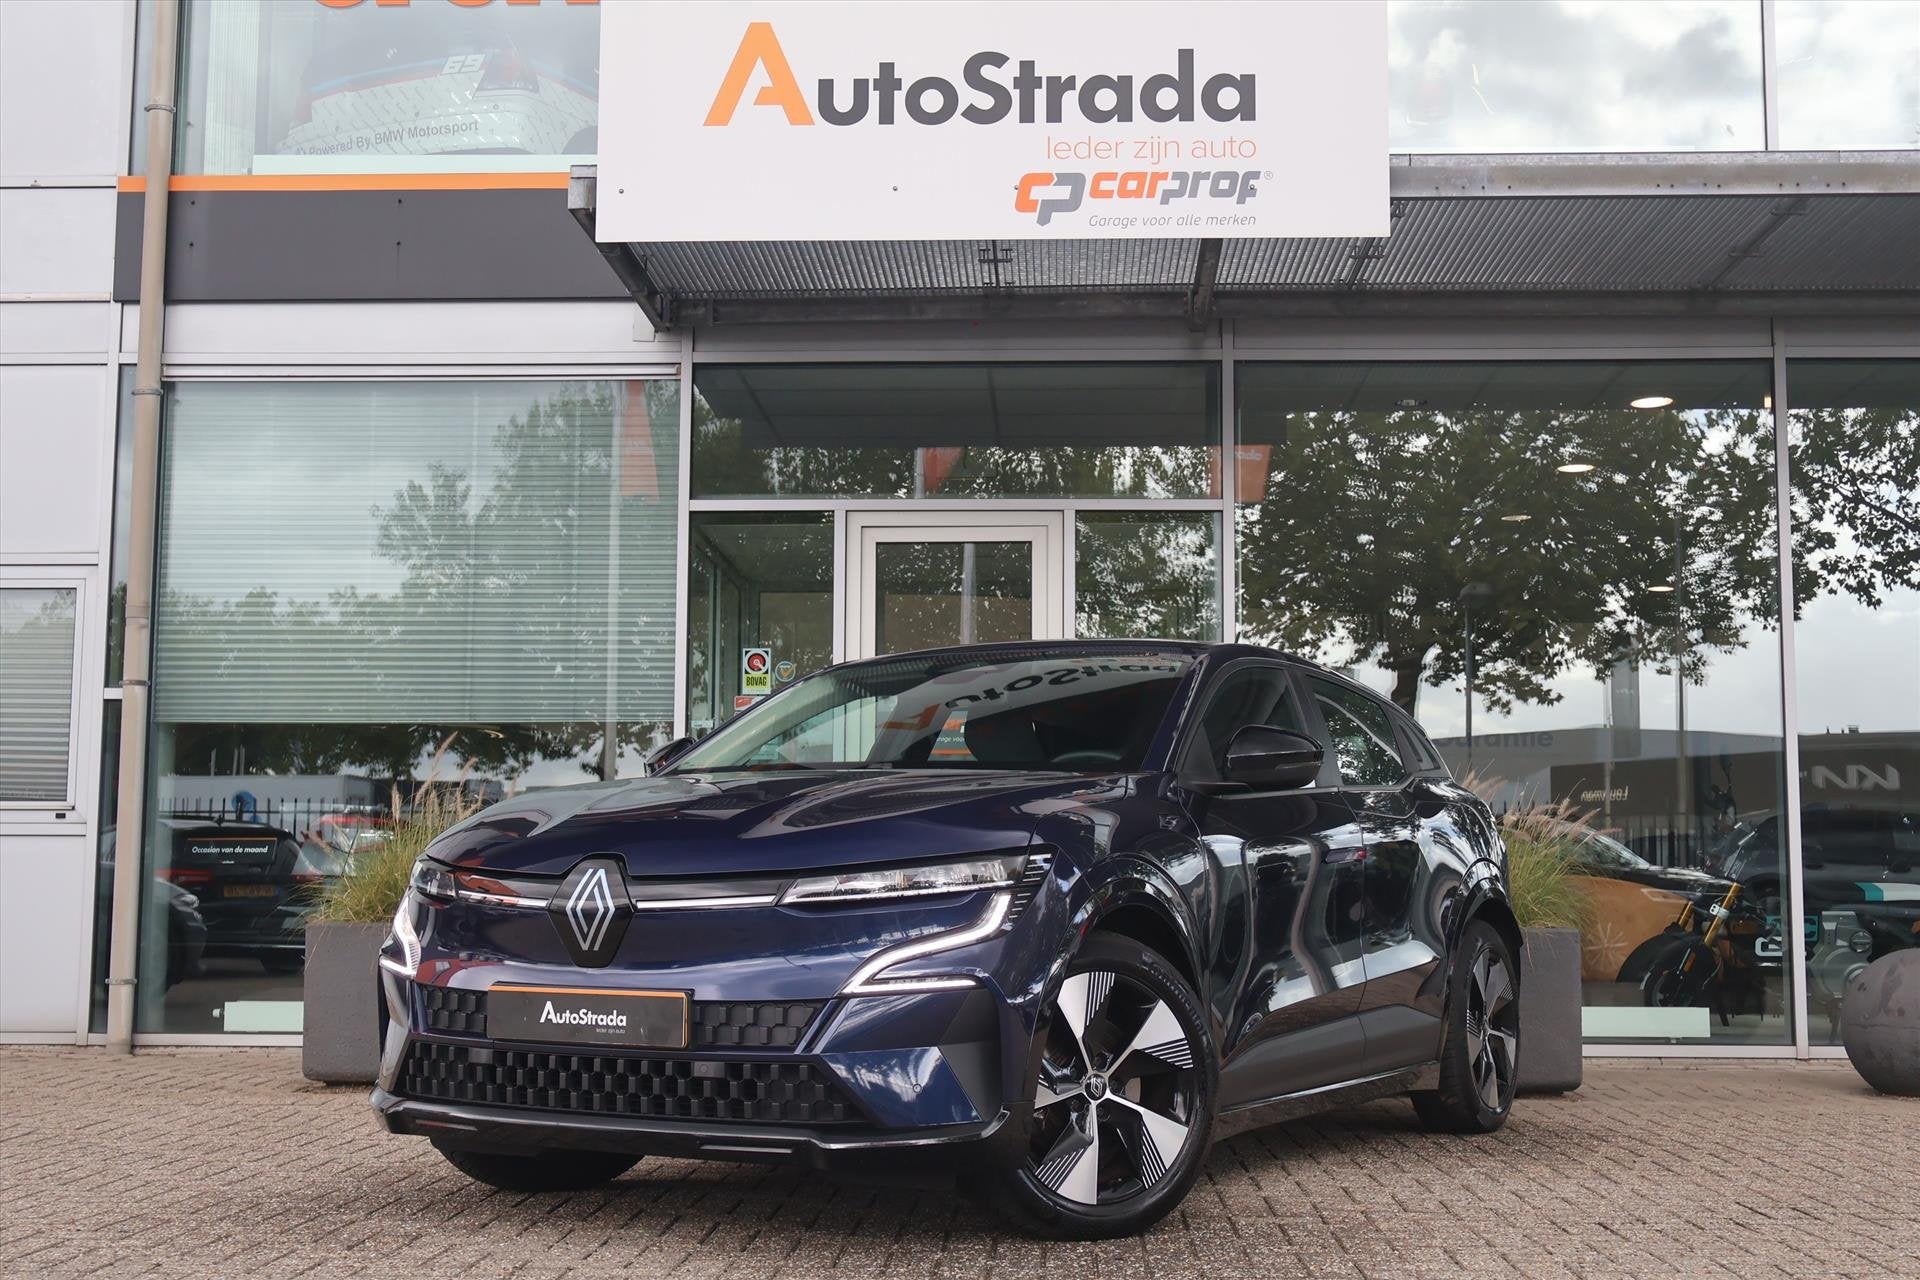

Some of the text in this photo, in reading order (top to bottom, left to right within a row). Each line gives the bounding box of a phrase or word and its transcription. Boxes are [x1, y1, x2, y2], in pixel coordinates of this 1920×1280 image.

[440, 54, 485, 75] 69
[703, 22, 1257, 126] AutoStrada
[356, 133, 371, 150] By
[374, 127, 405, 146] BMW
[407, 119, 479, 140] Motorsport
[1047, 136, 1257, 165] Ieder zijn auto
[1088, 213, 1257, 230] Garage voor alle merken
[746, 676, 768, 687] BOVAG
[192, 845, 220, 853] Occasion
[234, 845, 243, 853] de
[244, 845, 268, 853] maand
[540, 1001, 627, 1026] AutoStrada
